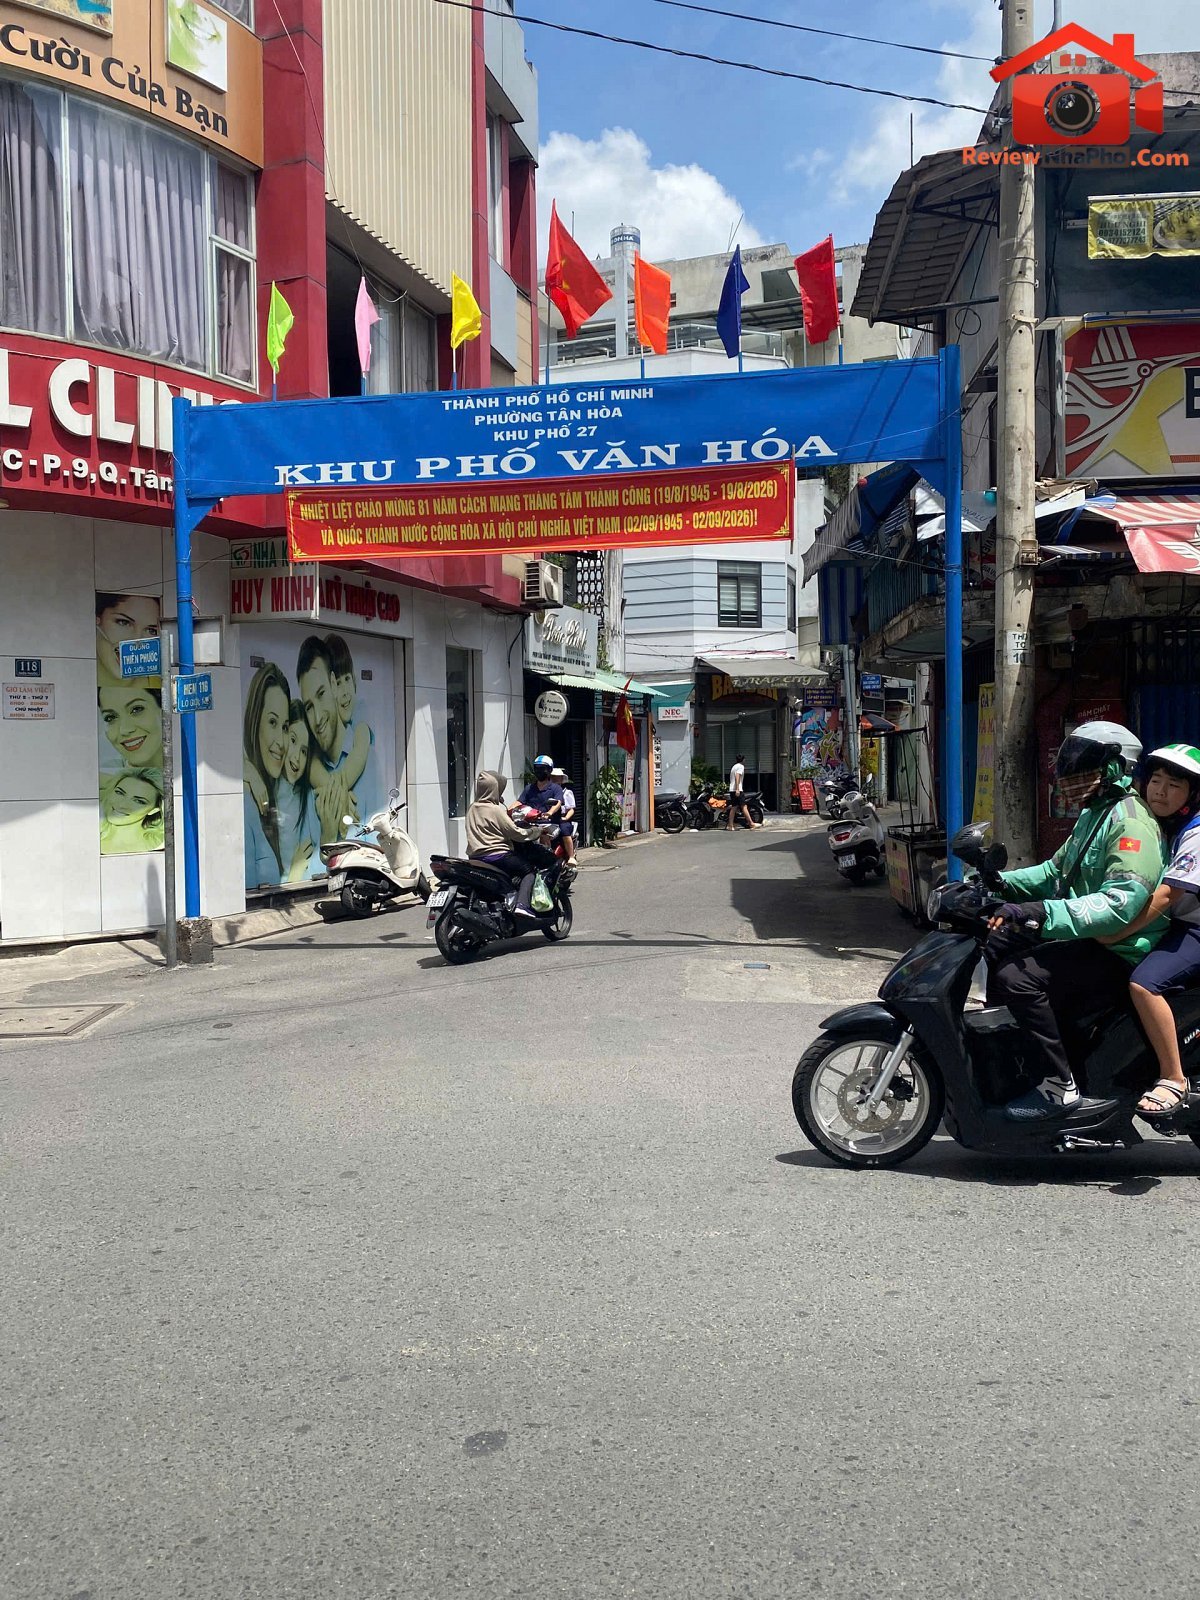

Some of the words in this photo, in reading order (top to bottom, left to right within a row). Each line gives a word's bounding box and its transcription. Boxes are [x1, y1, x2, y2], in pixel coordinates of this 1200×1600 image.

[101, 57, 167, 107] Của
[175, 85, 228, 138] Bạn
[442, 396, 499, 411] THÀNH
[506, 391, 542, 407] PHỐ
[547, 389, 570, 404] HỒ
[576, 387, 605, 402] CHÍ
[610, 387, 654, 401] MINH
[474, 410, 543, 425] PHƯỜNG
[547, 407, 581, 421] TÂN
[588, 405, 623, 419] HÒA
[494, 429, 528, 441] KHU
[535, 423, 572, 440] PHỐ
[577, 426, 598, 437] 27
[274, 460, 396, 486] KHU
[416, 442, 541, 478] PHỐ
[557, 440, 681, 471] VĂN
[702, 427, 838, 463] HÓA
[301, 500, 329, 523] NHIỆT
[332, 499, 352, 522] LIỆT
[356, 498, 382, 518] CHÀO
[385, 497, 416, 517] MỪNG
[419, 499, 430, 515] 81
[433, 496, 457, 515] NĂM
[460, 494, 487, 513] CÁCH
[490, 495, 520, 516] MẠNG
[523, 491, 557, 511] THÁNG
[560, 489, 582, 509] TÁM
[585, 487, 619, 507] THÀNH
[622, 485, 651, 506] CÔNG
[654, 484, 710, 506] (19/8/1945
[721, 480, 778, 500] 19/8/2026)
[320, 526, 335, 546] VÀ
[337, 523, 363, 547] QUỐC
[366, 523, 398, 544] KHÁNH
[401, 521, 428, 542] NƯỚC
[431, 522, 457, 545] CỘNG
[461, 520, 480, 541] HÒA
[483, 520, 496, 539] XÃ
[499, 518, 515, 542] HỘI
[518, 515, 538, 538] CHỦ
[540, 516, 571, 536] NGHĨA
[573, 515, 595, 539] VIỆT
[597, 517, 621, 534] NAM
[624, 513, 683, 535] (02/09/1945
[692, 508, 758, 529] 02/09/2026)!
[253, 541, 277, 569] NHA
[232, 577, 264, 614] HUY
[271, 575, 314, 612] MINH
[20, 661, 38, 671] 118
